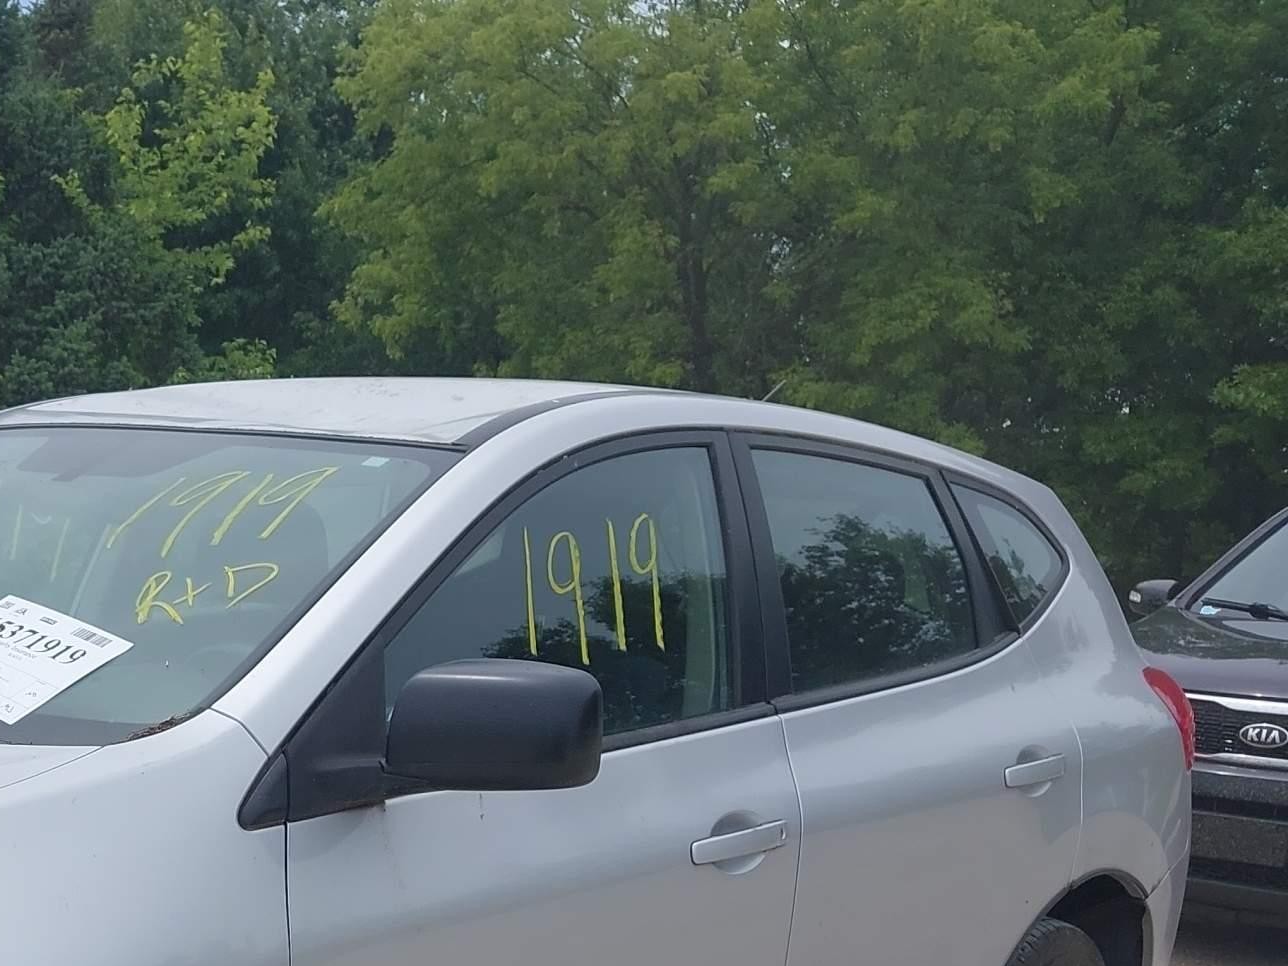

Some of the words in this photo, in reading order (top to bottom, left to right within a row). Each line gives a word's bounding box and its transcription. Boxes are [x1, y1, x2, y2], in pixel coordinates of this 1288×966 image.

[106, 466, 340, 558] 1919
[523, 512, 665, 665] 1919
[1247, 727, 1281, 744] KIA
